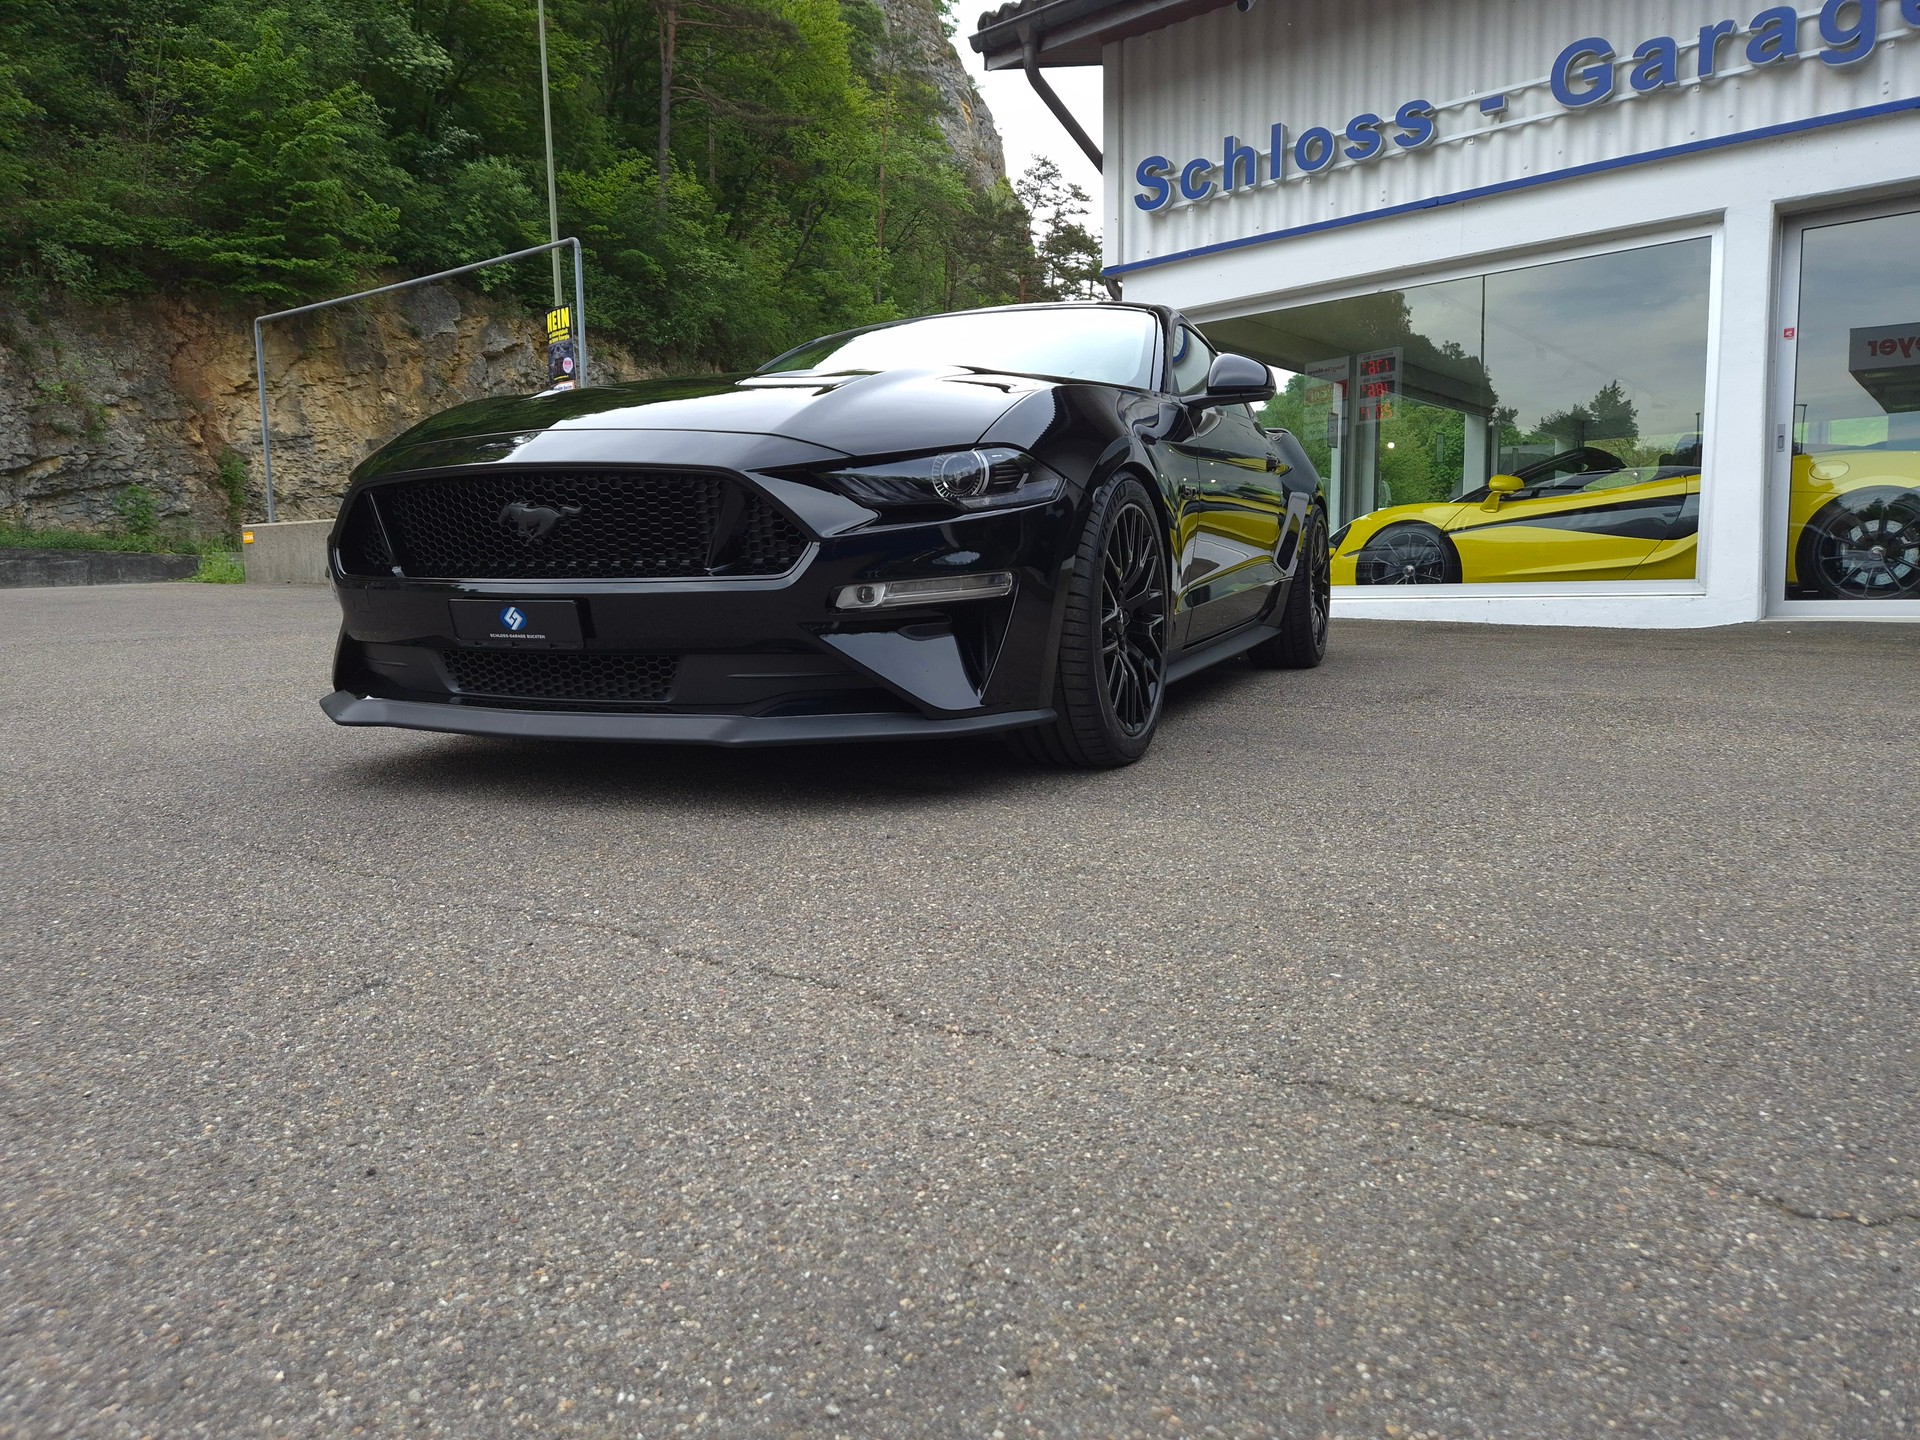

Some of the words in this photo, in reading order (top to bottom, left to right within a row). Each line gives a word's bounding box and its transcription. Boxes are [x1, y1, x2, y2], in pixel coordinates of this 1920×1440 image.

[1134, 99, 1438, 213] Schloss
[1550, 0, 1920, 112] Garag
[547, 307, 570, 333] NEIN
